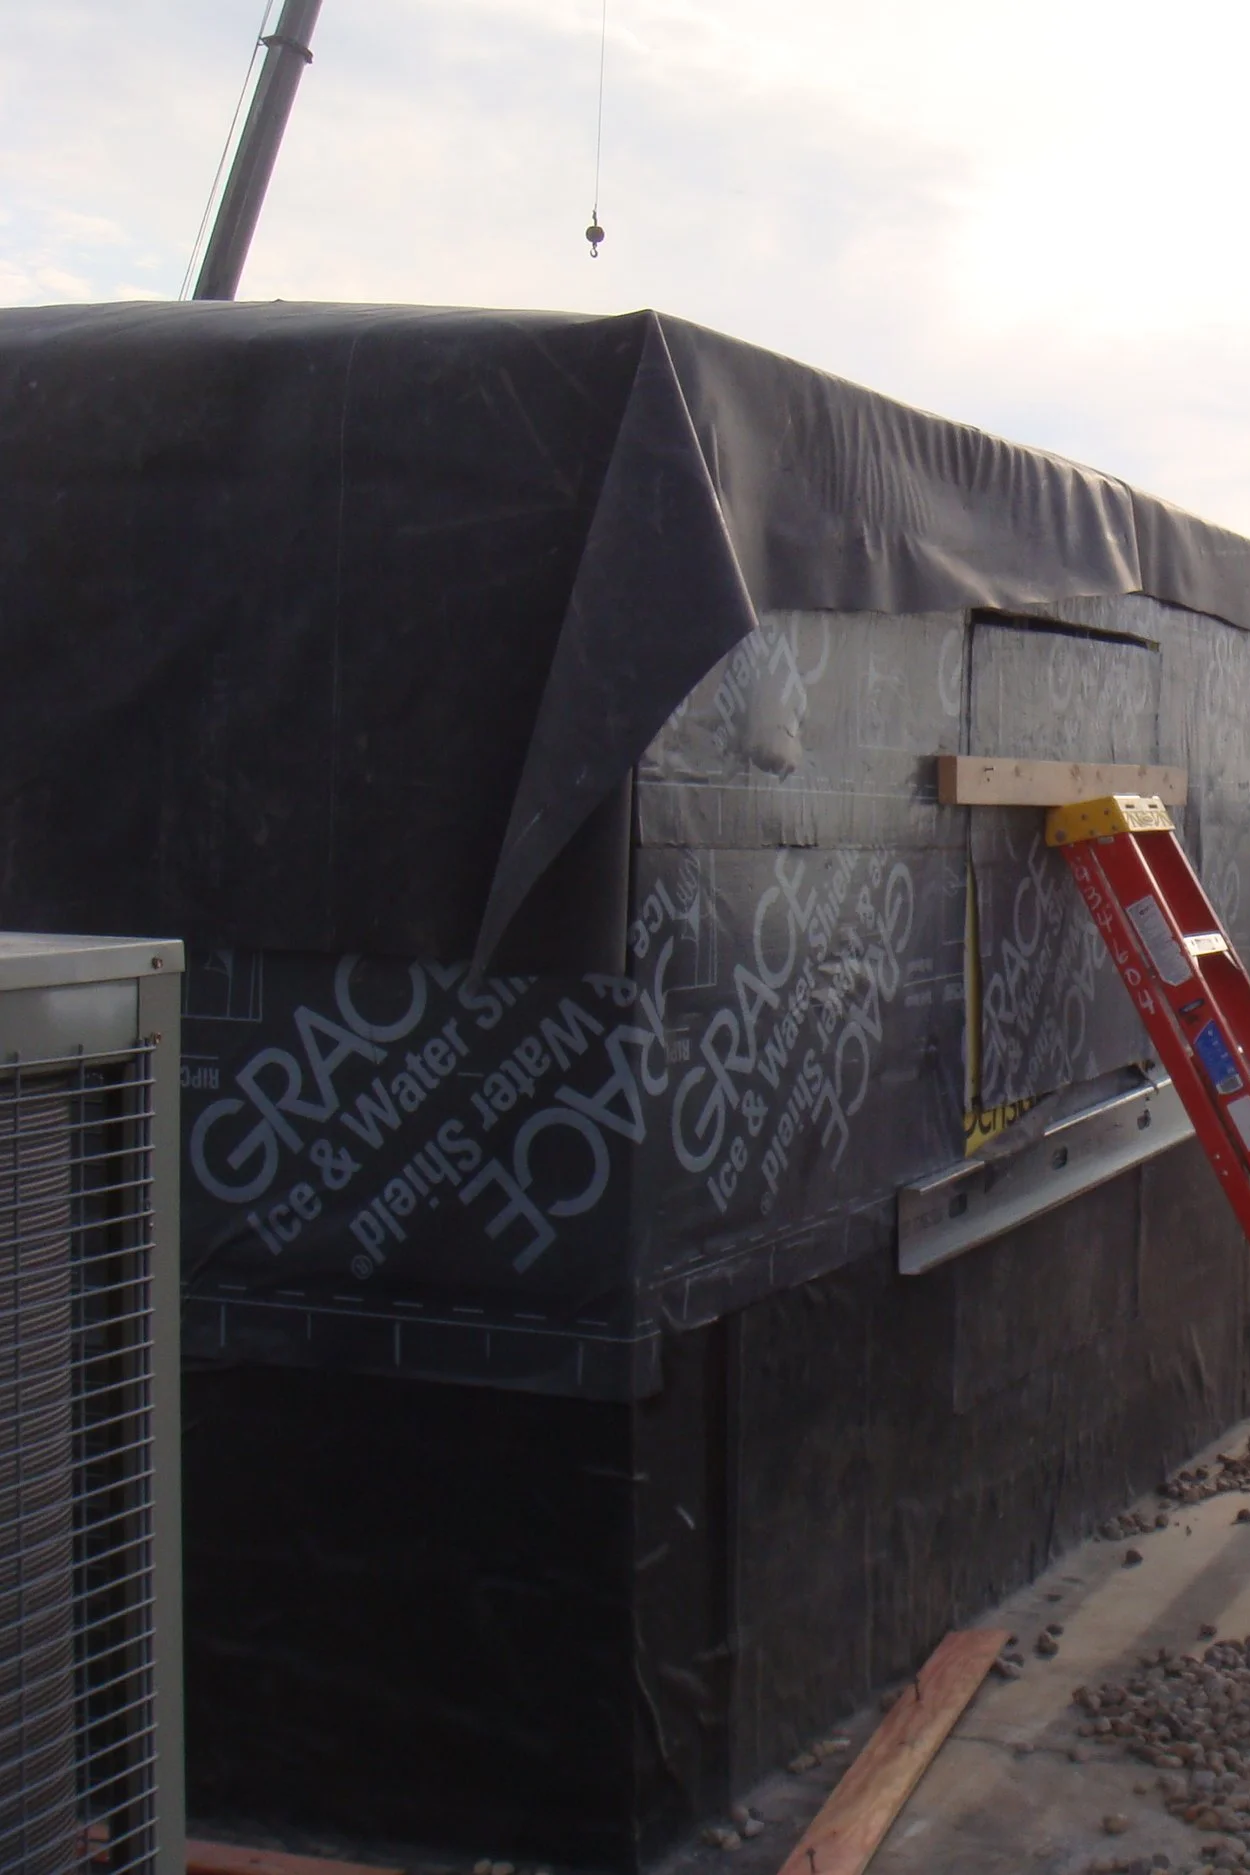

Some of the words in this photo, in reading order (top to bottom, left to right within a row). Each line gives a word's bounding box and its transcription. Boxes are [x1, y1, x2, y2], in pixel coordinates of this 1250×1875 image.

[180, 1067, 220, 1090] RIPC
[470, 996, 605, 1132] Water
[672, 849, 819, 1173] GRACE
[706, 1136, 749, 1214] Ice
[741, 1090, 768, 1137] &
[758, 963, 816, 1089] Water
[812, 862, 914, 1172] GRACE
[247, 1181, 323, 1257] Ice
[309, 1138, 363, 1190] &
[340, 1016, 472, 1151] Water
